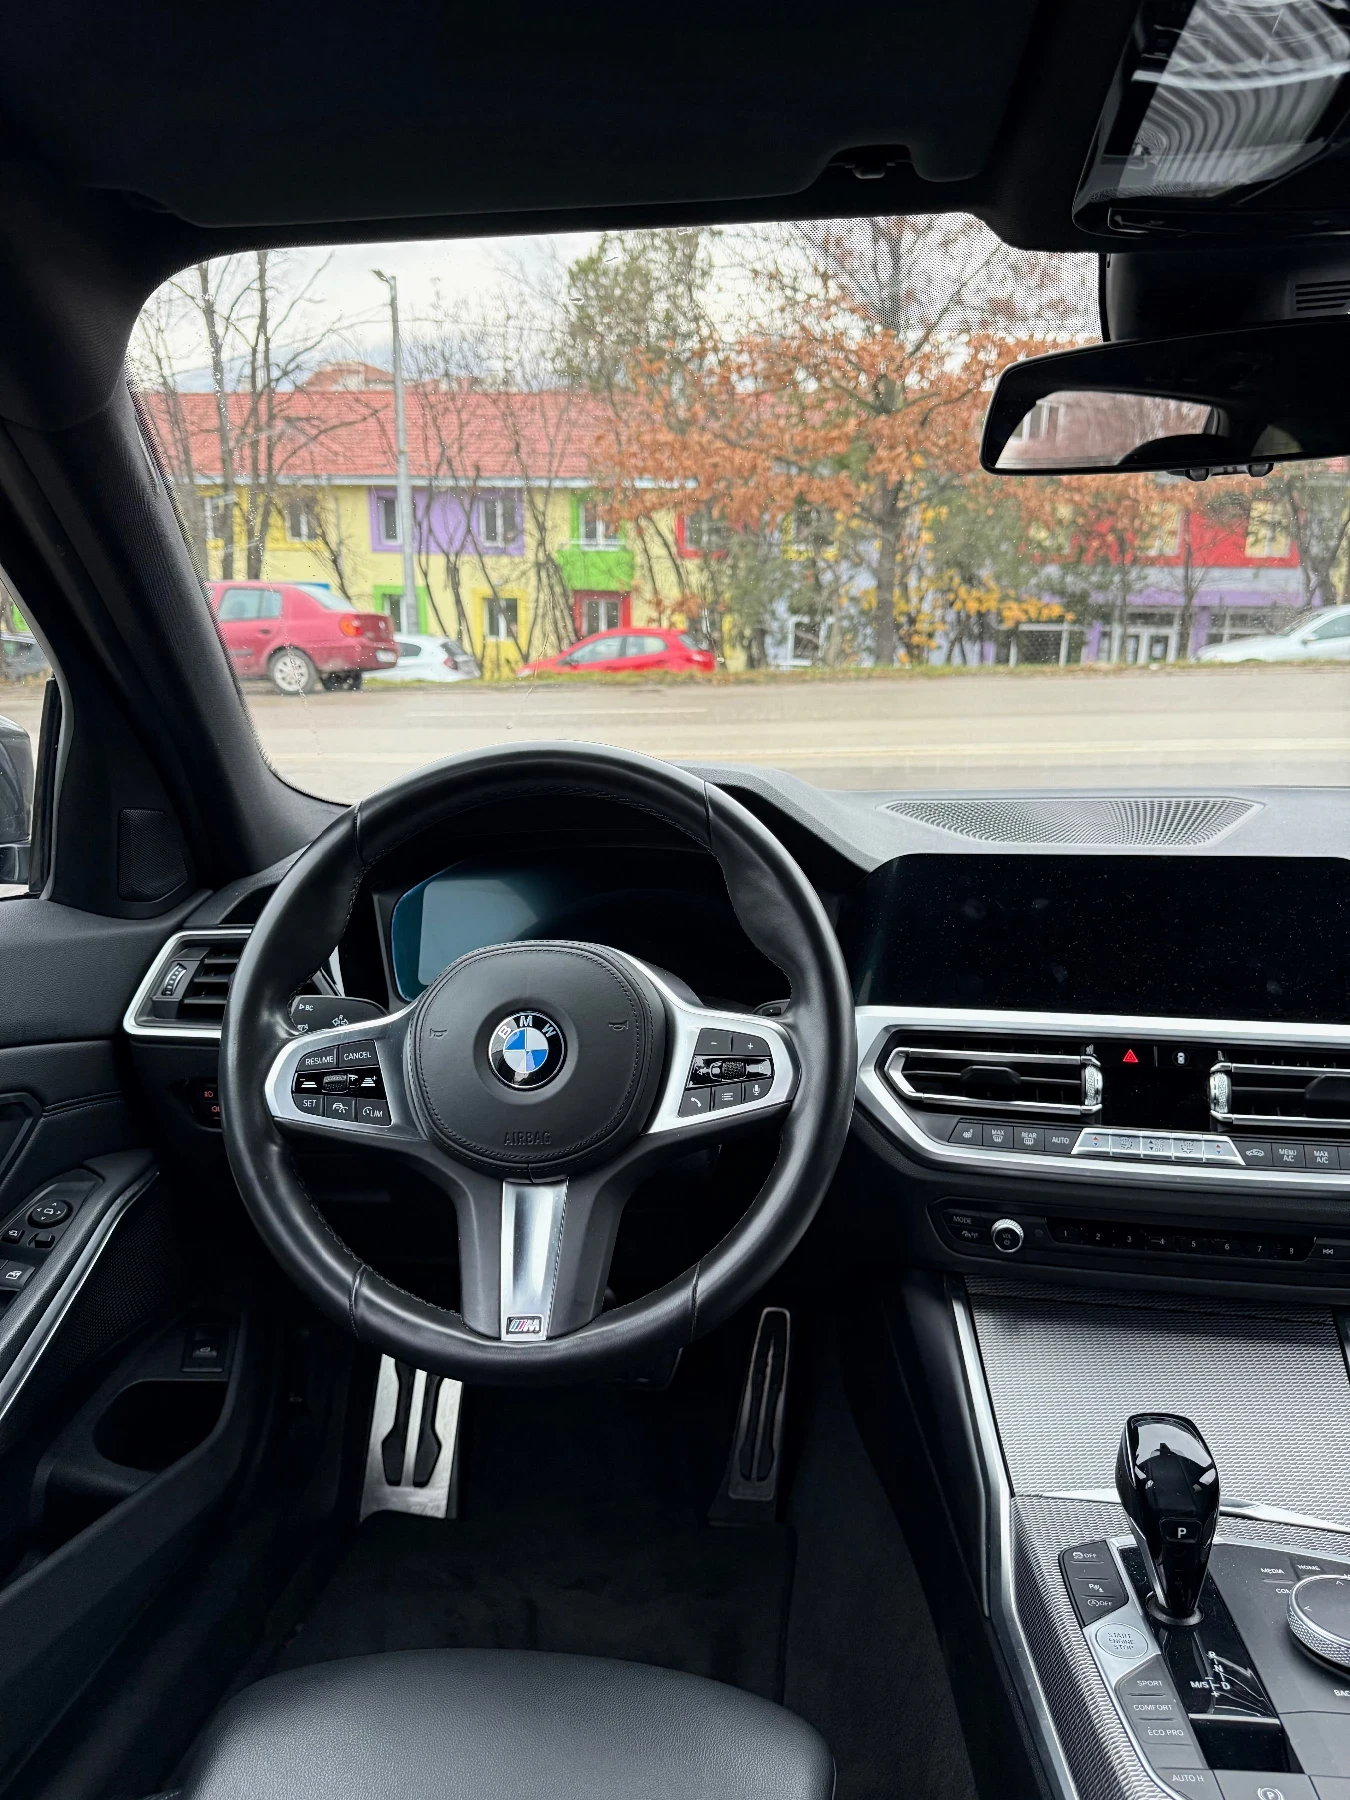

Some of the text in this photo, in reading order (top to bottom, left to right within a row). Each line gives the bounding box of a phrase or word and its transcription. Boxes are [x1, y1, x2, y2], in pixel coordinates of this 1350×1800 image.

[497, 1015, 557, 1039] BMW
[305, 1055, 334, 1066] RESUME
[343, 1051, 372, 1061] CANCEL
[302, 1099, 317, 1108] SET
[370, 1108, 383, 1118] LIM
[503, 1131, 552, 1146] AIRBAG
[1021, 1131, 1037, 1139] REAR
[1051, 1136, 1070, 1144] AUTO
[1278, 1148, 1297, 1156] MENU
[1316, 1156, 1329, 1164] A/C
[953, 1215, 973, 1224] MODE
[1126, 1235, 1132, 1243] 3
[1191, 1240, 1197, 1248] 5
[1224, 1243, 1230, 1251] 6
[1257, 1245, 1263, 1253] 7
[1177, 1527, 1187, 1539] P
[1260, 1567, 1286, 1575] MEDIA
[1107, 1631, 1132, 1639] START
[1208, 1651, 1216, 1659] R
[1214, 1664, 1224, 1673] N
[1189, 1680, 1210, 1689] M/S
[1221, 1681, 1231, 1690] D
[1171, 1774, 1196, 1782] AUTO
